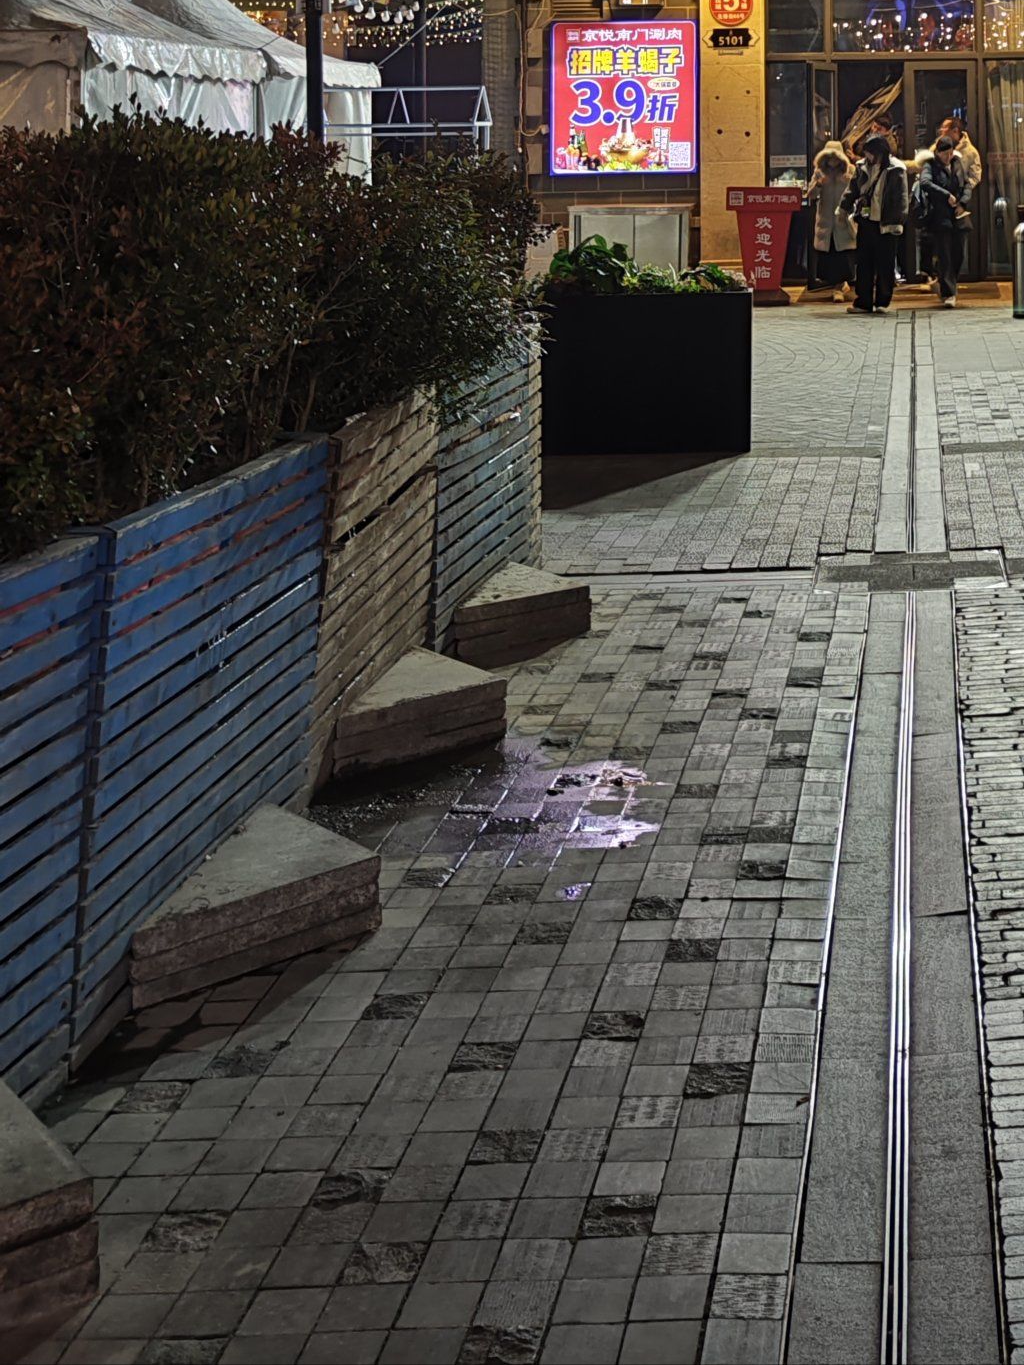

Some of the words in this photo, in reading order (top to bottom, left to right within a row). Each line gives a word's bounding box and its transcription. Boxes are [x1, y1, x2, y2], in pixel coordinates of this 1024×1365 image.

[582, 27, 682, 42] 京悦南门涮肉
[718, 35, 743, 46] 5101
[568, 47, 683, 75] 招牌羊蝎子
[571, 80, 678, 125] 3.9折
[754, 216, 773, 279] 欢迎光临
